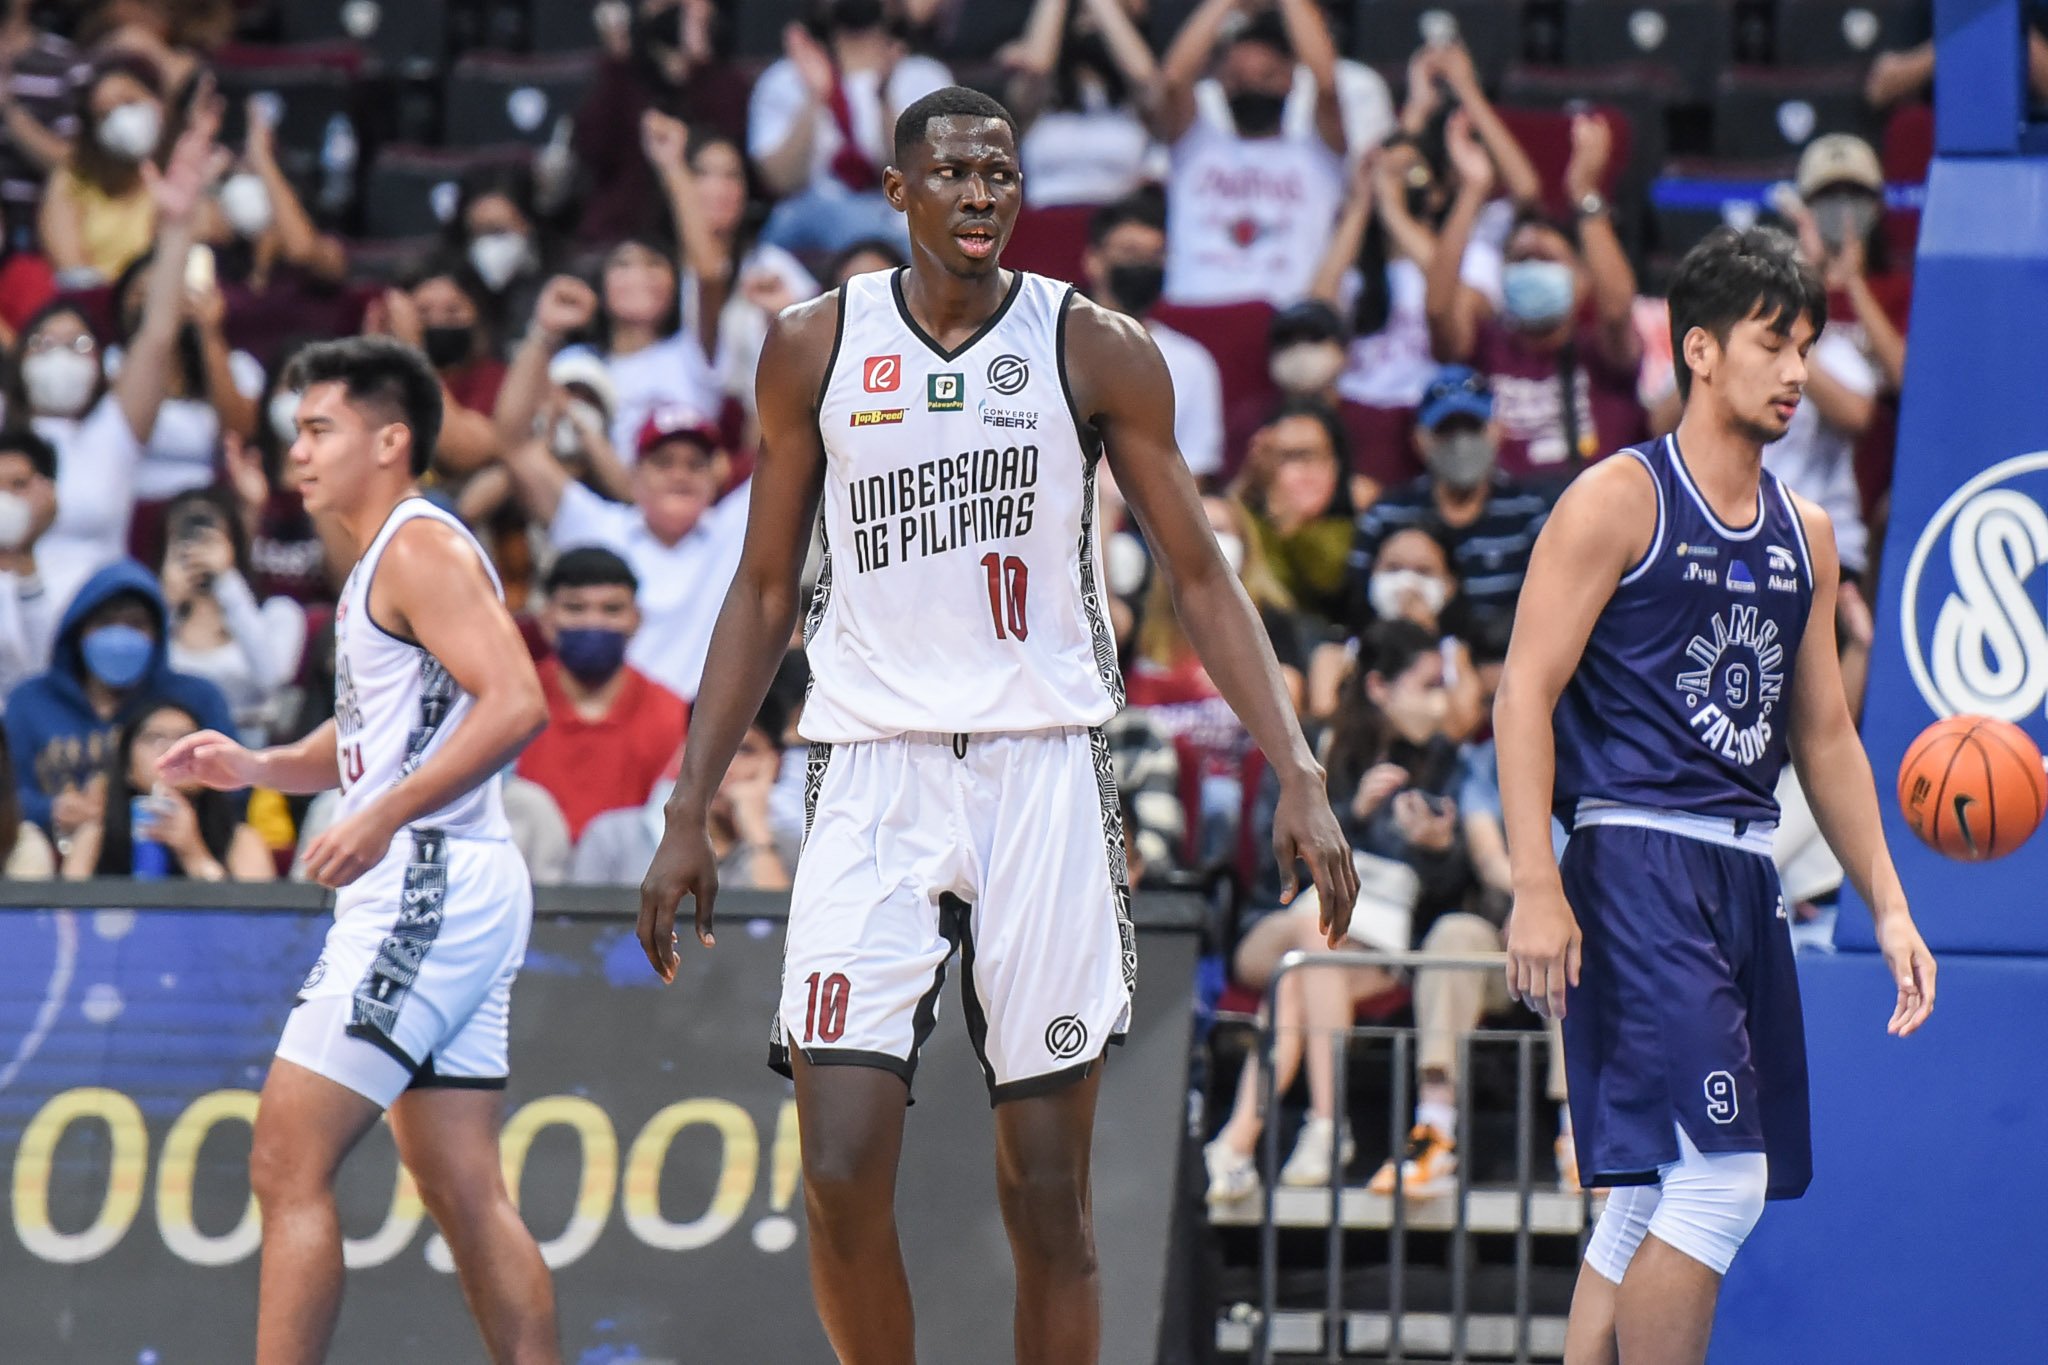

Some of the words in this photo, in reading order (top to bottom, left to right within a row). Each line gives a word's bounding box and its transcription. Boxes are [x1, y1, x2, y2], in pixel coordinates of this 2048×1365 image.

[851, 410, 903, 426] TopBreed
[928, 401, 964, 409] PalawanPay
[984, 408, 1039, 419] CONVERGE
[849, 445, 1039, 525] UNIBERSIDAD
[854, 523, 889, 573] NG
[900, 492, 1035, 562] PILIPINAS
[980, 552, 1029, 642] 10
[1676, 604, 1784, 702] ADAMSON
[1726, 663, 1750, 709] 9
[803, 971, 851, 1042] 10
[1704, 1070, 1738, 1125] 9
